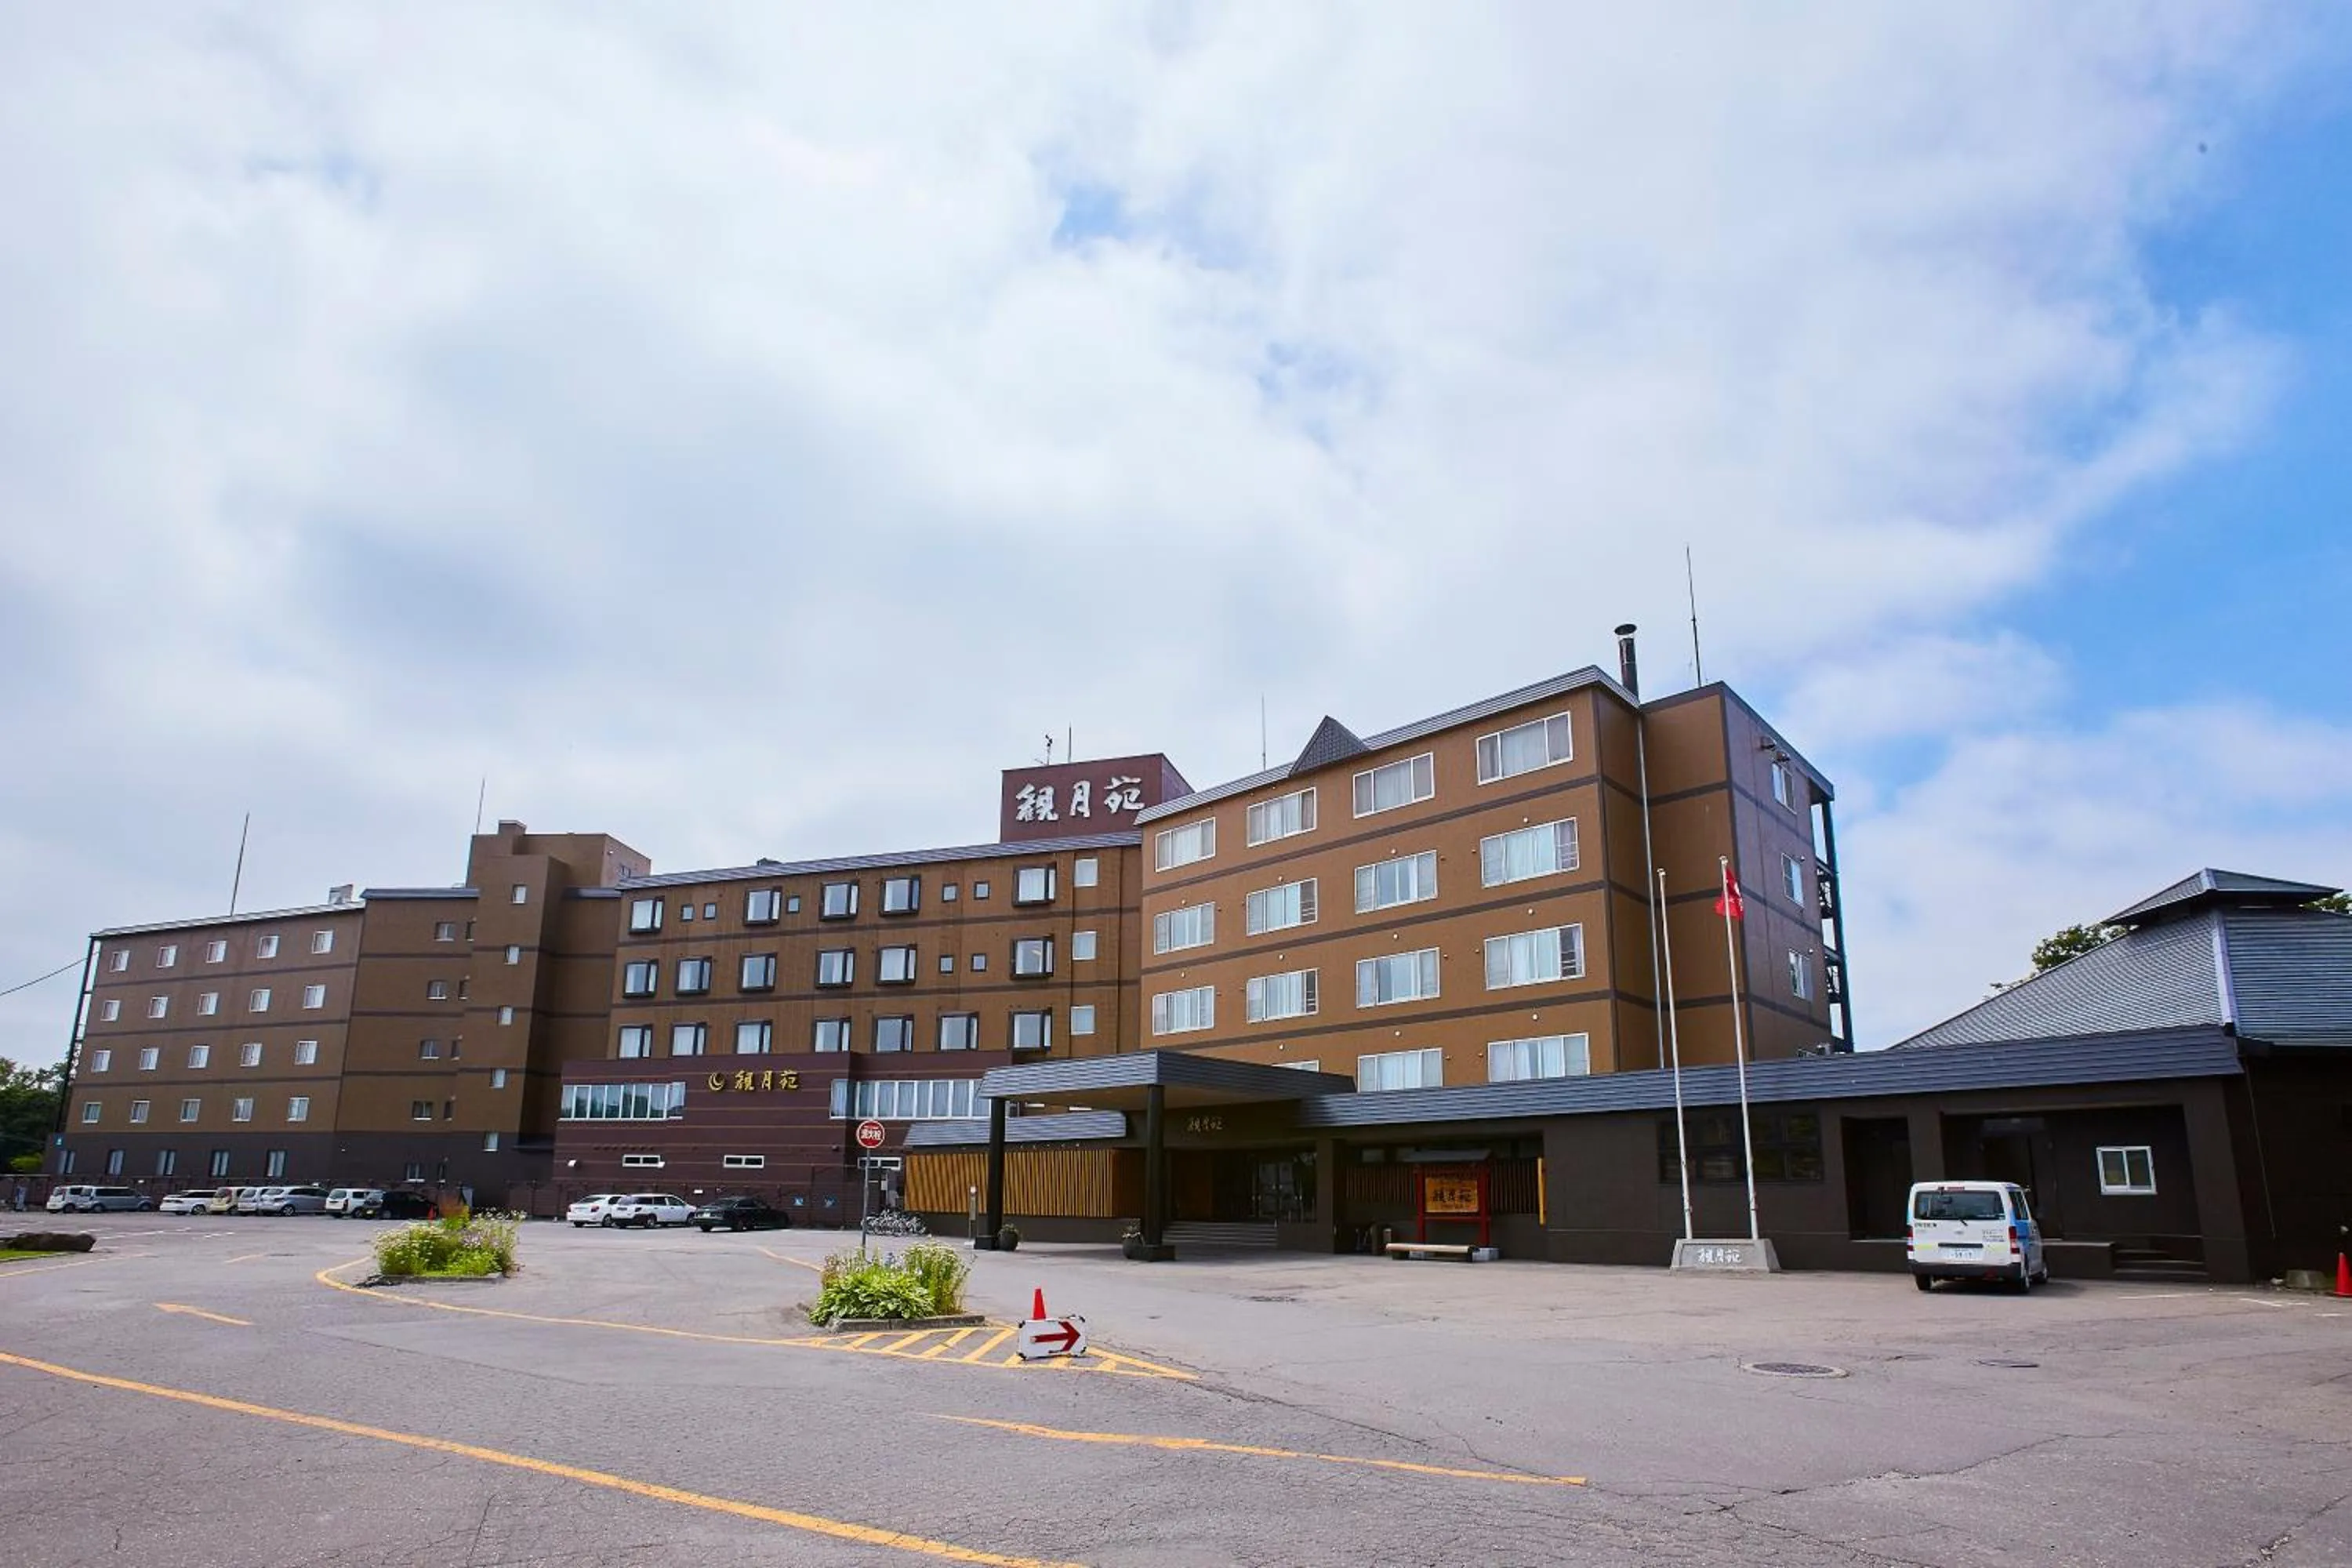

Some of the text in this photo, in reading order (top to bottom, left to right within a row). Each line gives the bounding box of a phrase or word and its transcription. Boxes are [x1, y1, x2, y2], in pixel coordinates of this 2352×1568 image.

[1015, 775, 1145, 822] 観月苑
[735, 1069, 798, 1091] 観月苑
